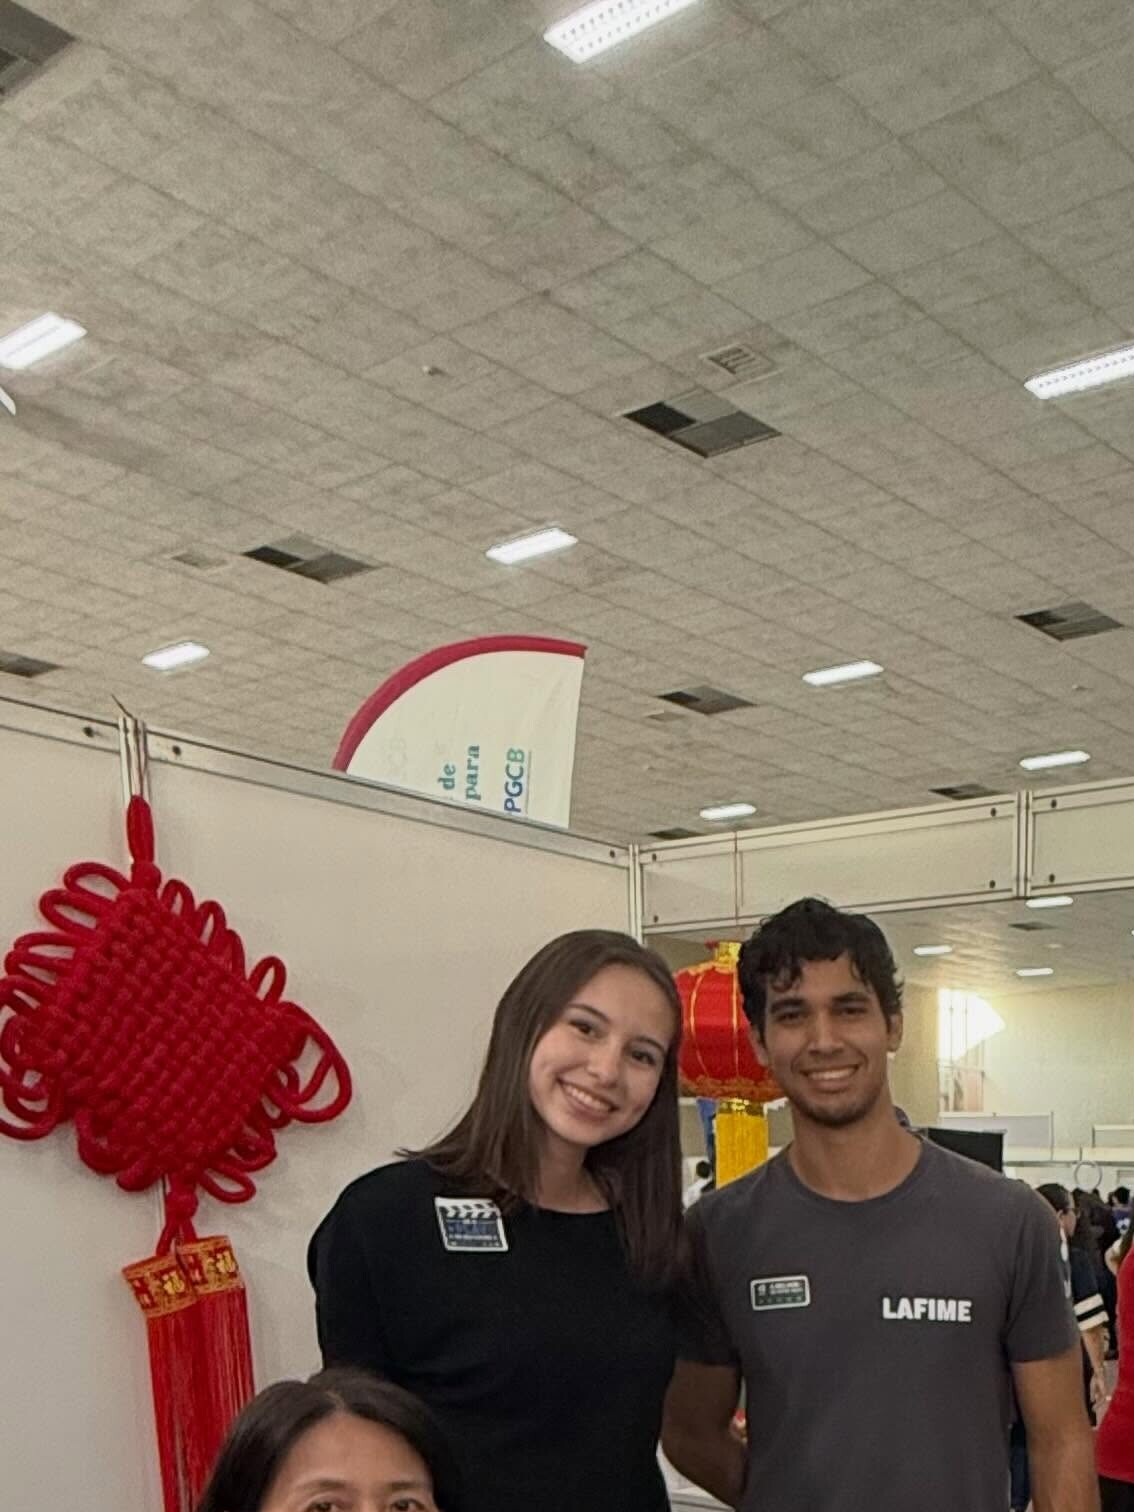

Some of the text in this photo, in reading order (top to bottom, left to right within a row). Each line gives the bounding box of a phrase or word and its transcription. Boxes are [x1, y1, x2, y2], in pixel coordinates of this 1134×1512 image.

[437, 763, 456, 790] de
[465, 745, 481, 800] para
[503, 747, 526, 813] PGCB
[882, 1297, 973, 1323] LAFIME
